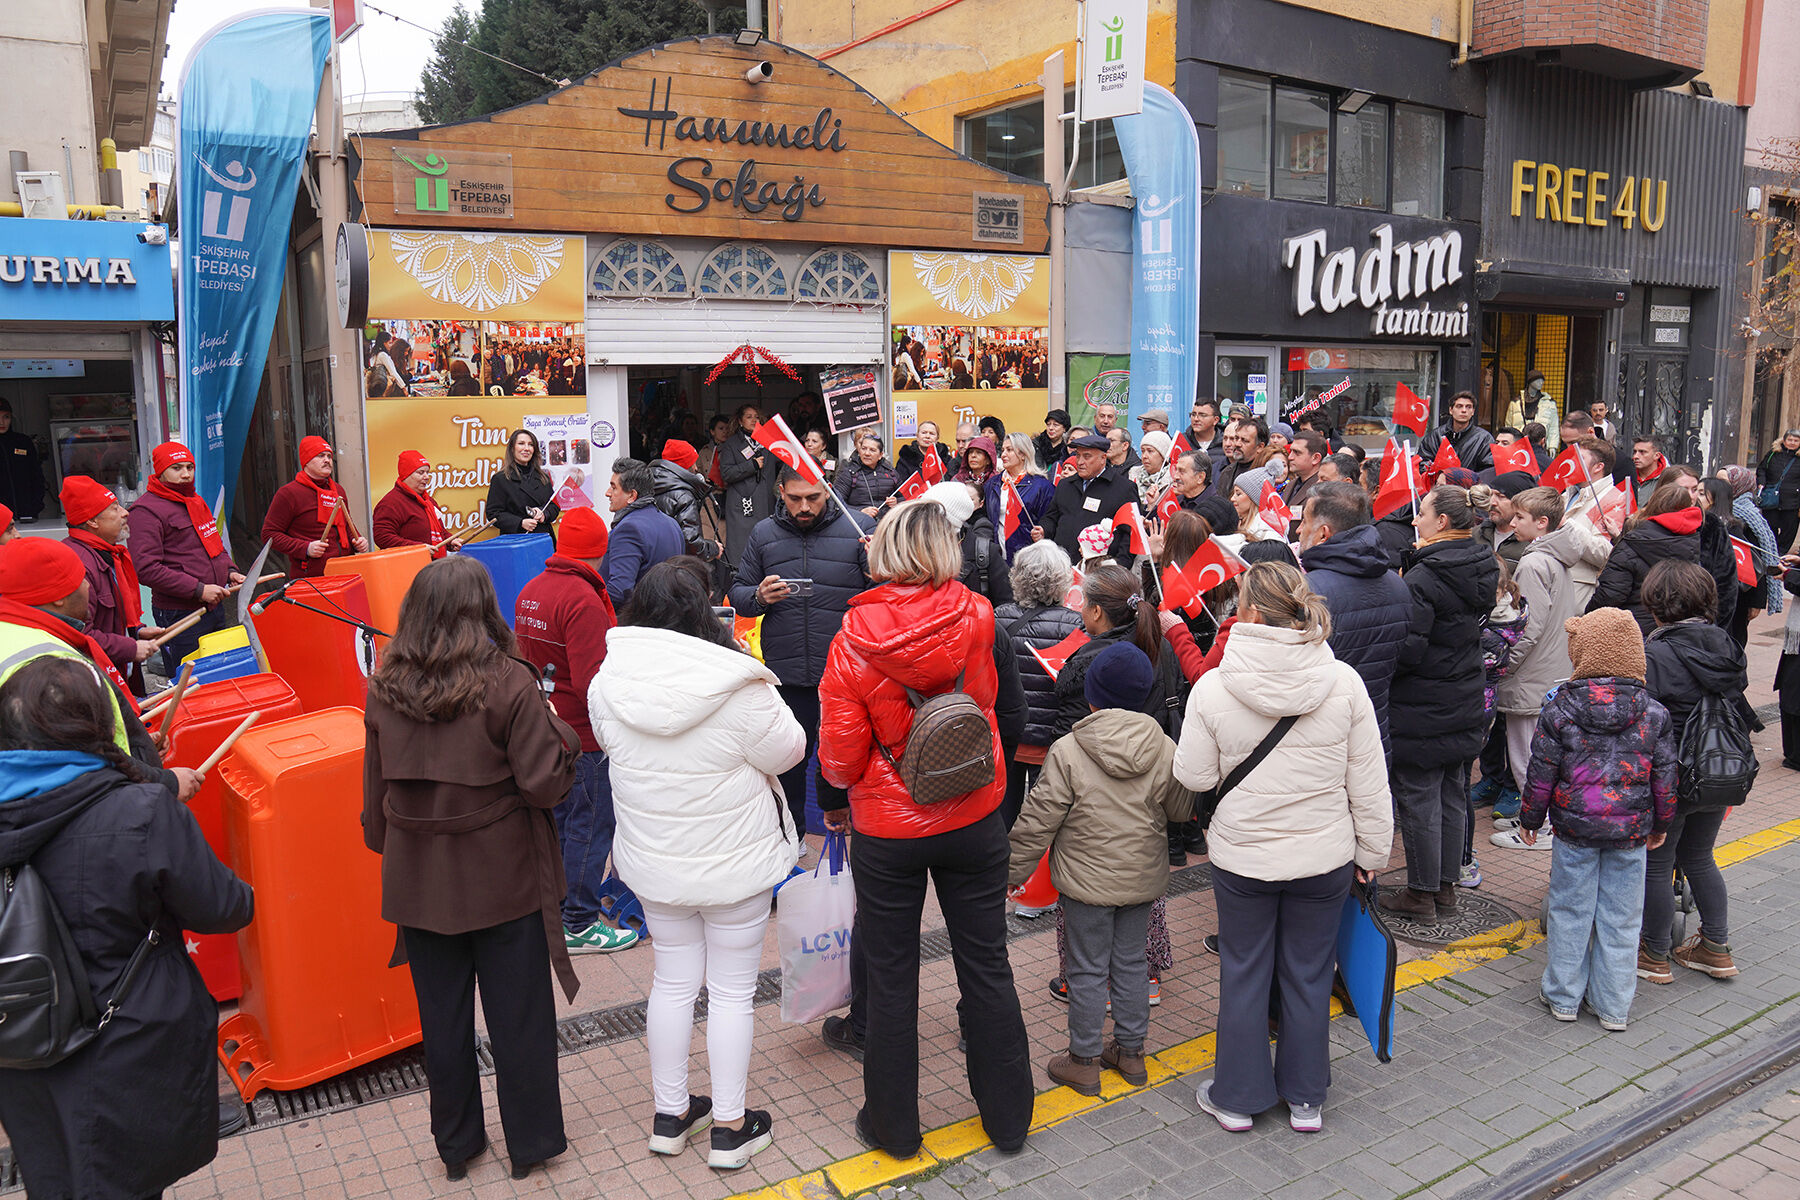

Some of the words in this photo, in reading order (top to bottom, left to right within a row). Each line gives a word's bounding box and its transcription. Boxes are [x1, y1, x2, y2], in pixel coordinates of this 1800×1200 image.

[1097, 71, 1128, 84] TEPEBAŞI
[617, 76, 848, 152] Hanımeli
[450, 189, 511, 207] TEPEBAŞI
[460, 180, 505, 191] ESKİŞEHİR
[665, 156, 827, 221] Sokağı
[461, 204, 505, 215] BELEDİYESİ
[199, 242, 250, 261] SKİŞEHİR
[1282, 222, 1463, 317] Tadım
[1370, 301, 1469, 338] tantuni
[1318, 375, 1351, 405] Tantuni
[452, 416, 510, 448] Tüm
